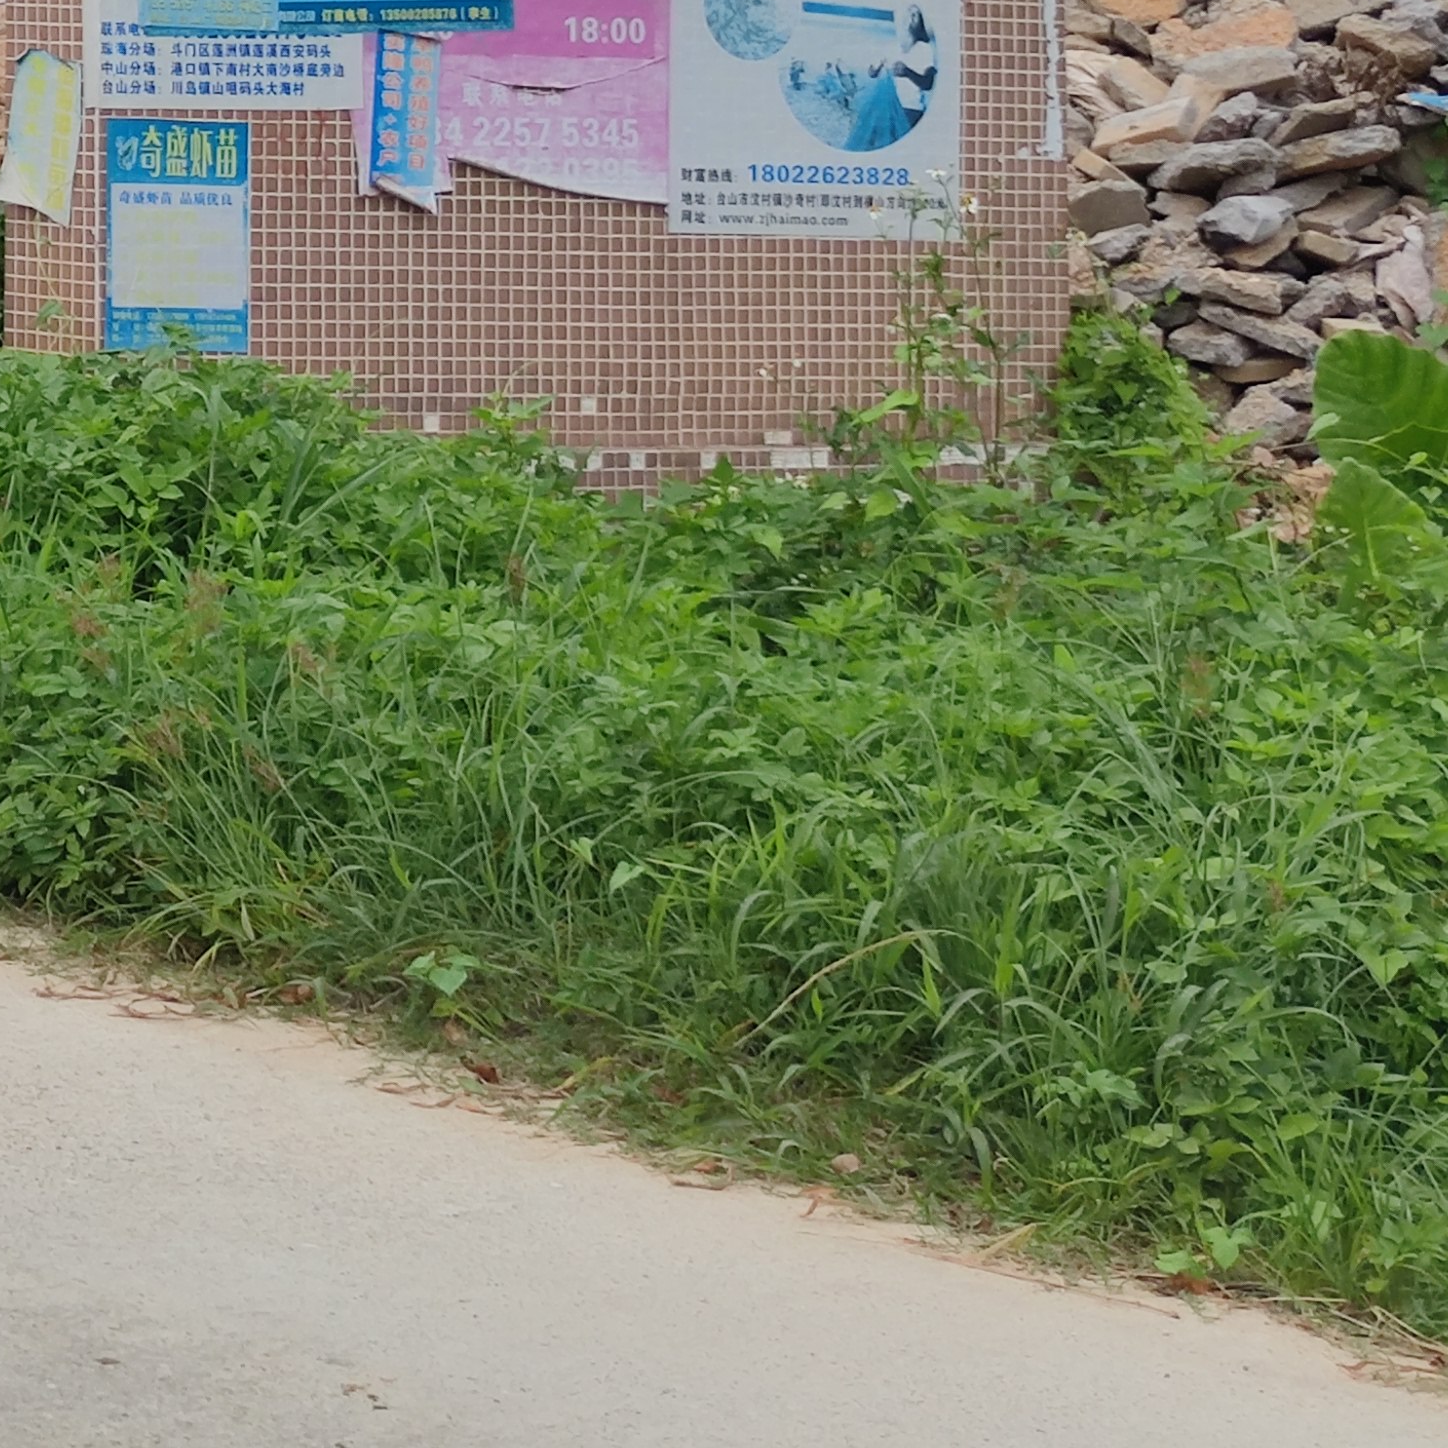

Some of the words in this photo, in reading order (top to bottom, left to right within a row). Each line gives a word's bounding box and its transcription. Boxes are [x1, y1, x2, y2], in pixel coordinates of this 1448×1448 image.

[564, 16, 646, 44] 18:00
[472, 116, 552, 148] 2257
[561, 117, 639, 148] 5345
[748, 164, 912, 186] 18022623828
